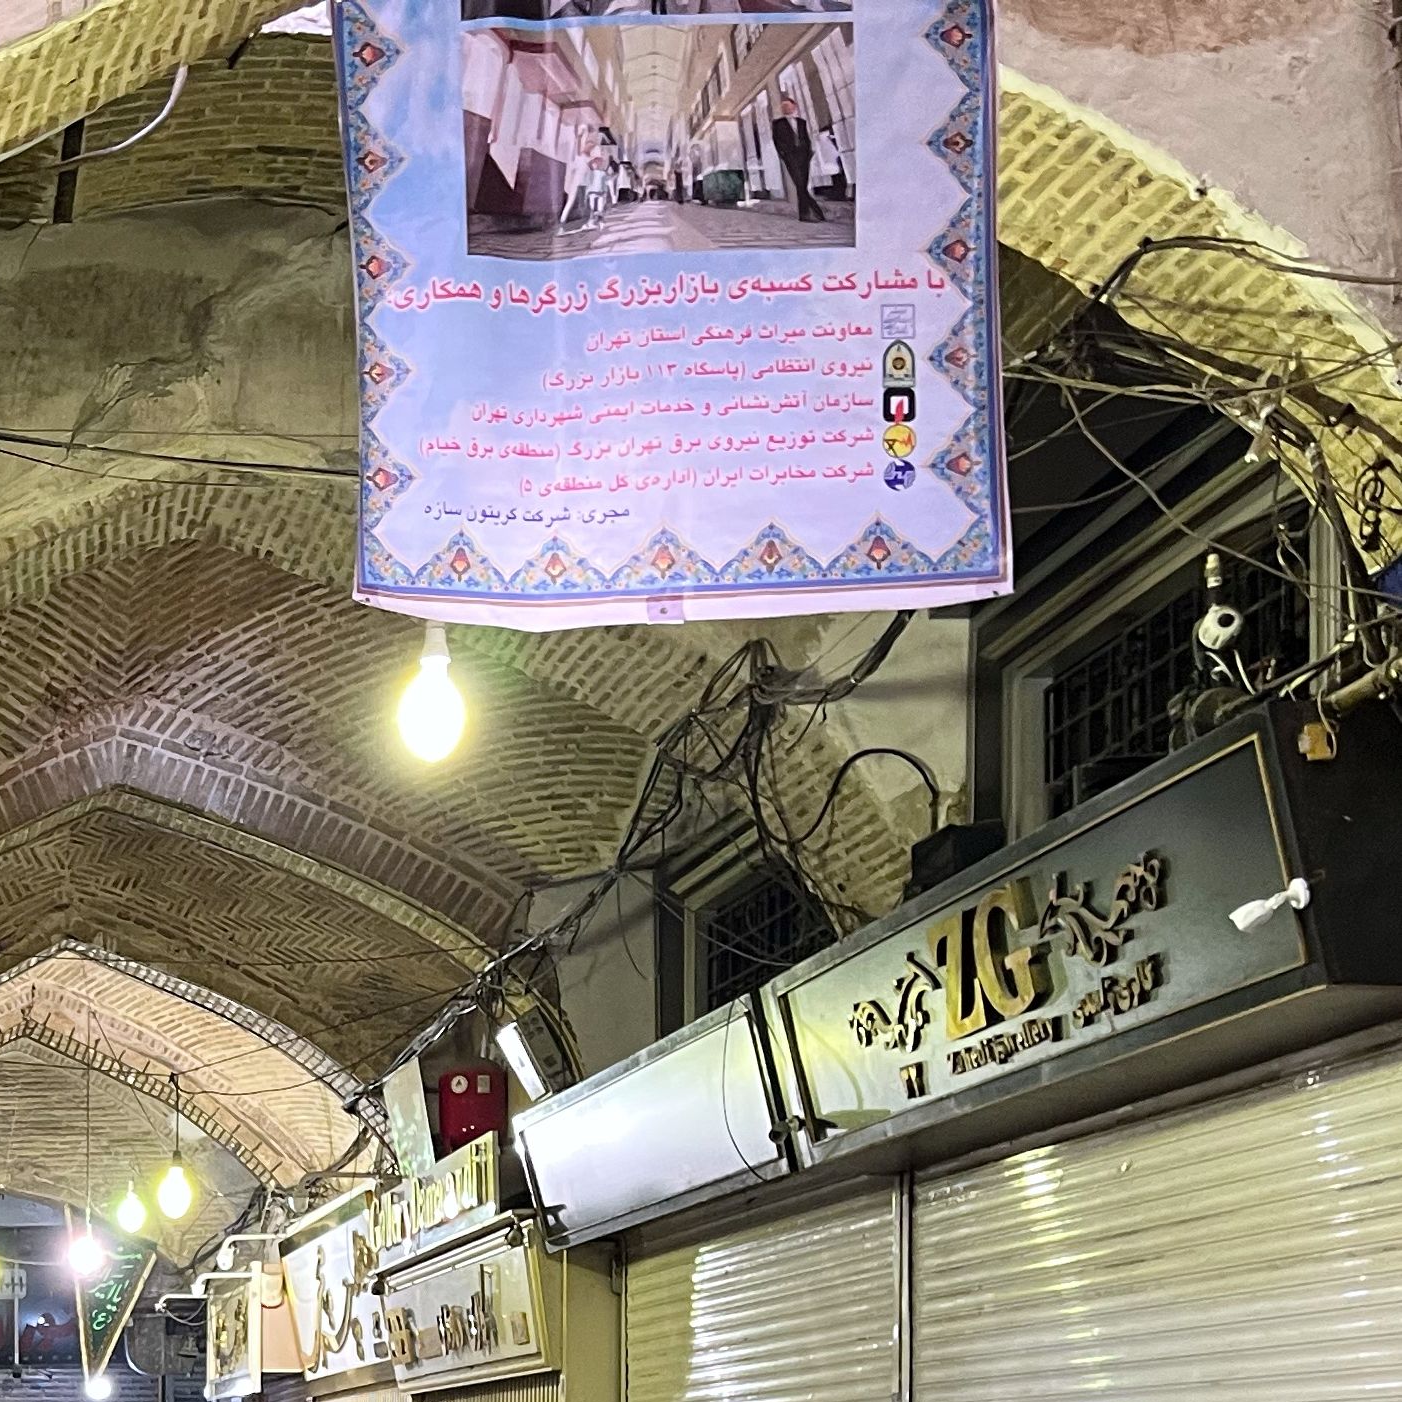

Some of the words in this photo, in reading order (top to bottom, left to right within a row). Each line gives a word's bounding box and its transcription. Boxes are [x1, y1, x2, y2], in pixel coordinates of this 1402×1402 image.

[821, 268, 919, 300] مشارکت
[926, 269, 945, 298] با
[488, 286, 503, 310] و
[508, 282, 589, 314] زرگرها
[585, 330, 632, 352] تهران
[637, 327, 686, 348] استان
[691, 323, 753, 346] فرهنگی
[757, 322, 806, 344] میراث
[811, 321, 874, 343] معاونت
[600, 364, 641, 389] بازار
[751, 358, 816, 380] انتظامی
[820, 356, 874, 378] نیروی
[471, 402, 509, 424] تهران
[588, 400, 635, 424] ایمنی
[639, 397, 695, 416] خدمات
[700, 401, 712, 416] و
[812, 391, 875, 413] سازمان
[512, 405, 584, 428] شهرداری
[465, 436, 495, 458] برق
[617, 436, 663, 457] تهران
[668, 432, 702, 454] برق
[707, 431, 761, 451] نیروی
[765, 429, 816, 452] توزیع
[821, 426, 875, 447] شرکت
[702, 465, 744, 488] ایران
[748, 465, 817, 486] مخابرات
[821, 460, 875, 483] شرکت
[608, 473, 630, 493] کل
[521, 505, 572, 528] شرکت
[926, 876, 1038, 1042] ZG
